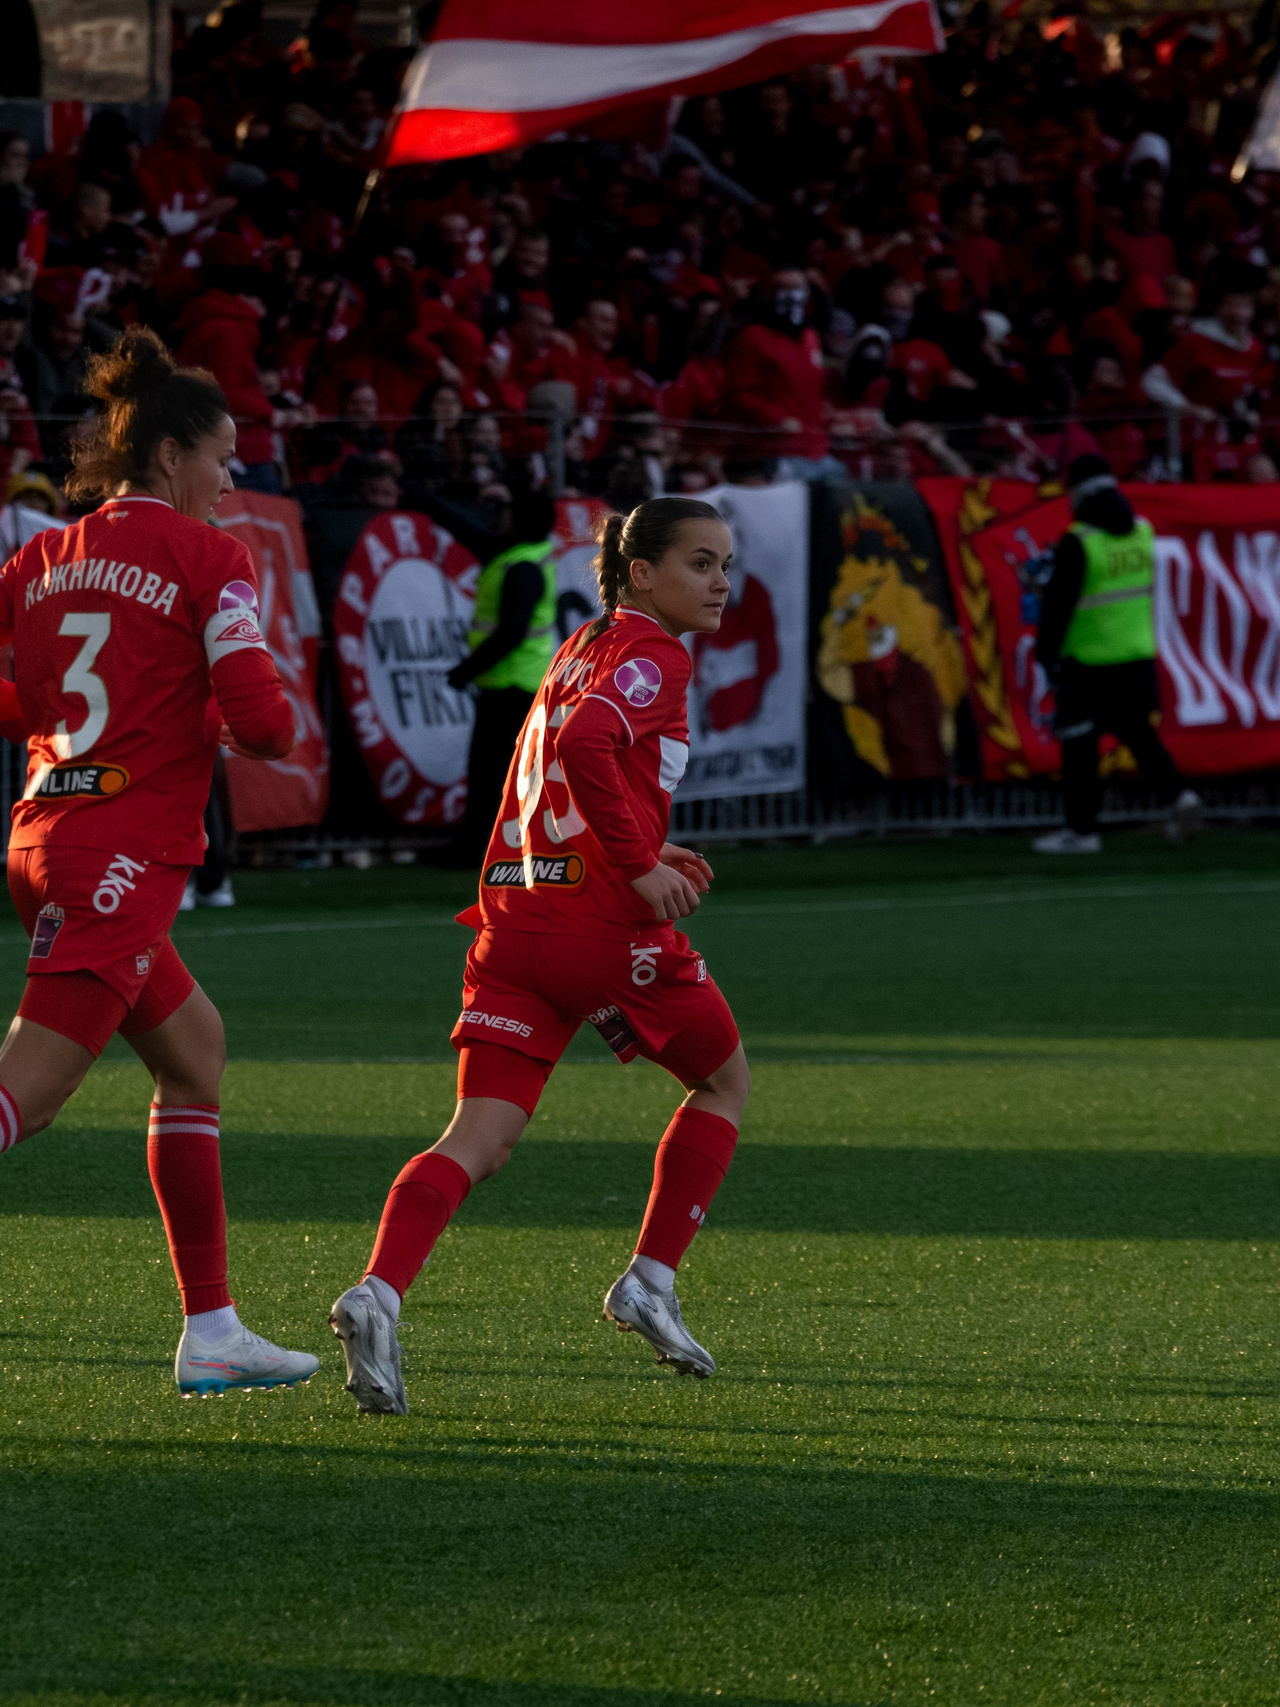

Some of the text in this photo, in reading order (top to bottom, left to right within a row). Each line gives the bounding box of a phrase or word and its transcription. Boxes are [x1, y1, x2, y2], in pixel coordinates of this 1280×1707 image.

[25, 557, 180, 616] КОЖНИКОВА
[56, 612, 112, 760] 3
[458, 1010, 534, 1038] GENESIS
